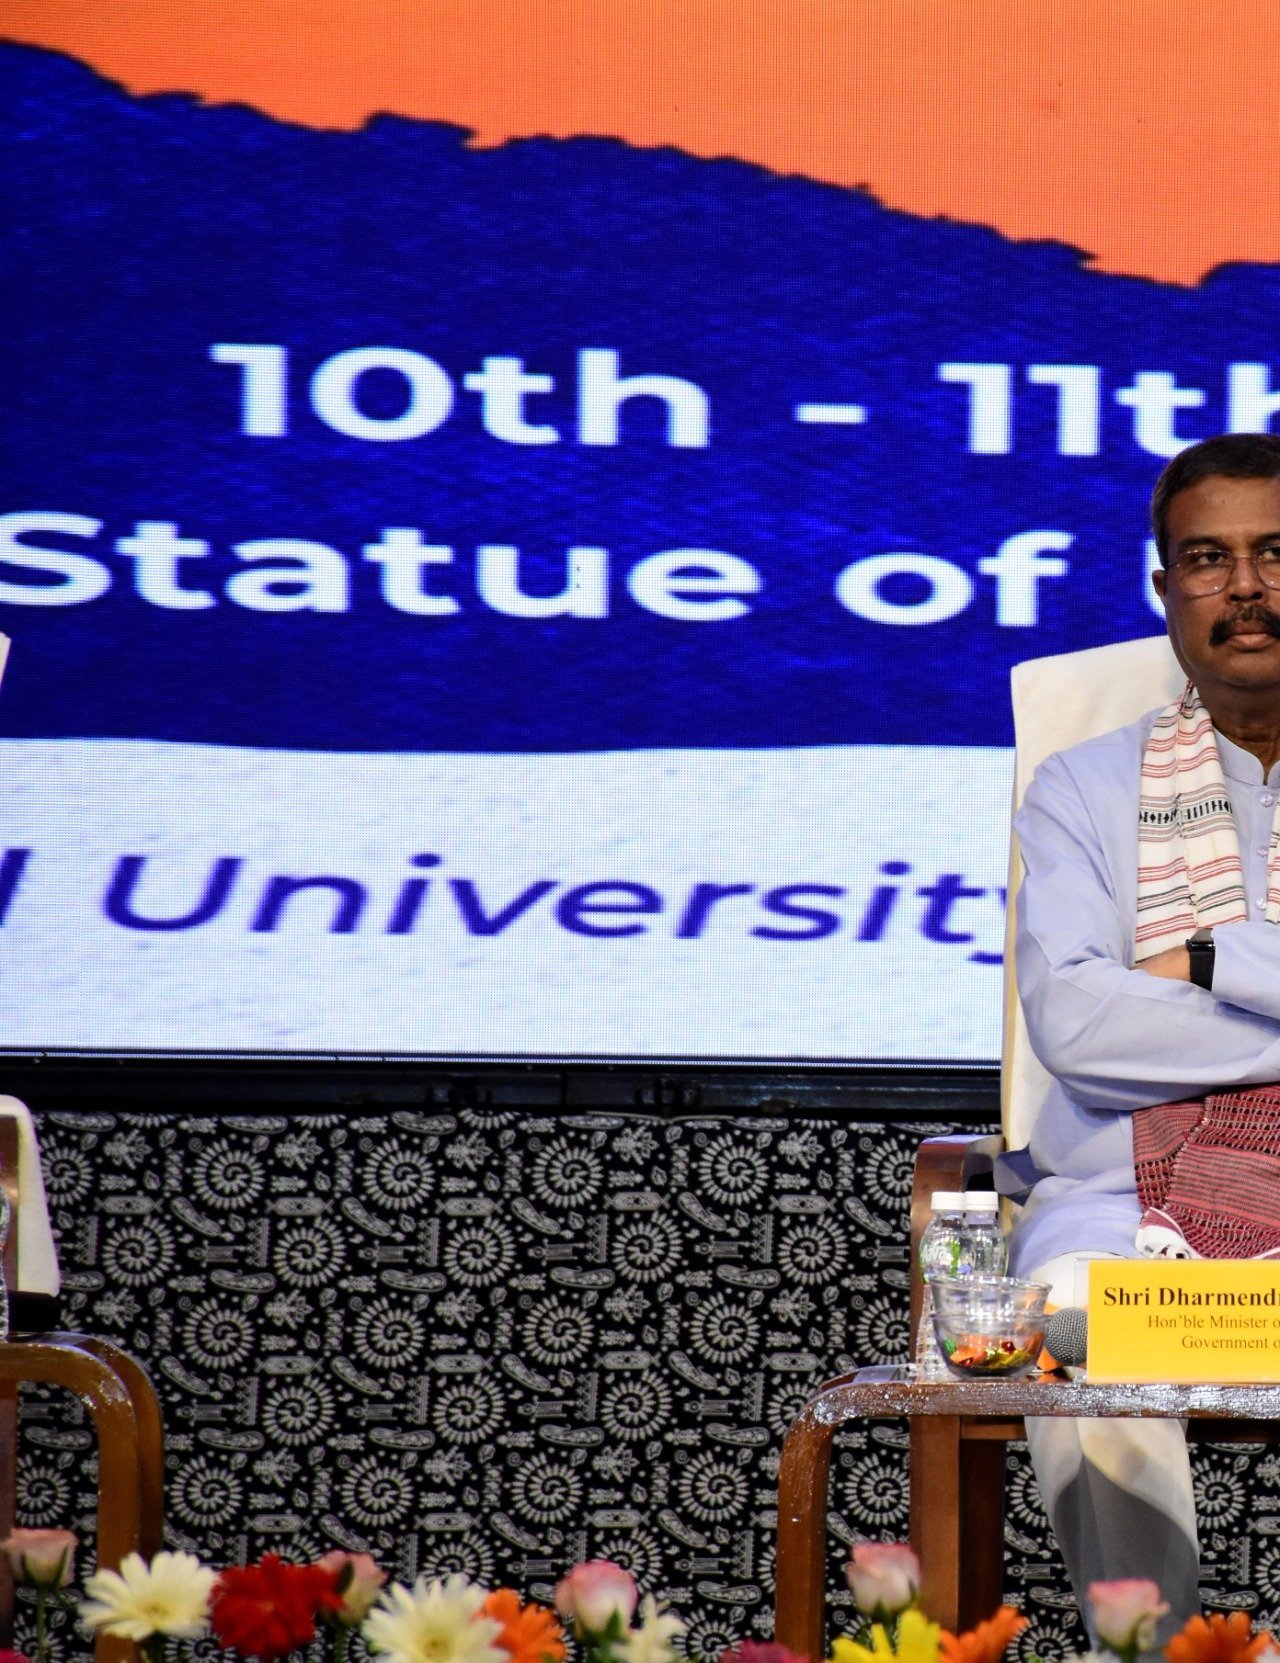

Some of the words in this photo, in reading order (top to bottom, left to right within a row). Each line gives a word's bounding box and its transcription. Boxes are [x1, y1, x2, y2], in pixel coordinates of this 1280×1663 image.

[211, 343, 710, 449] 10th
[796, 403, 867, 425] -
[0, 511, 763, 622] Statue
[835, 529, 1075, 627] of
[103, 853, 1006, 965] Universit
[1103, 1286, 1151, 1306] Shri
[1210, 1315, 1269, 1330] Minister
[1181, 1335, 1268, 1349] Government
